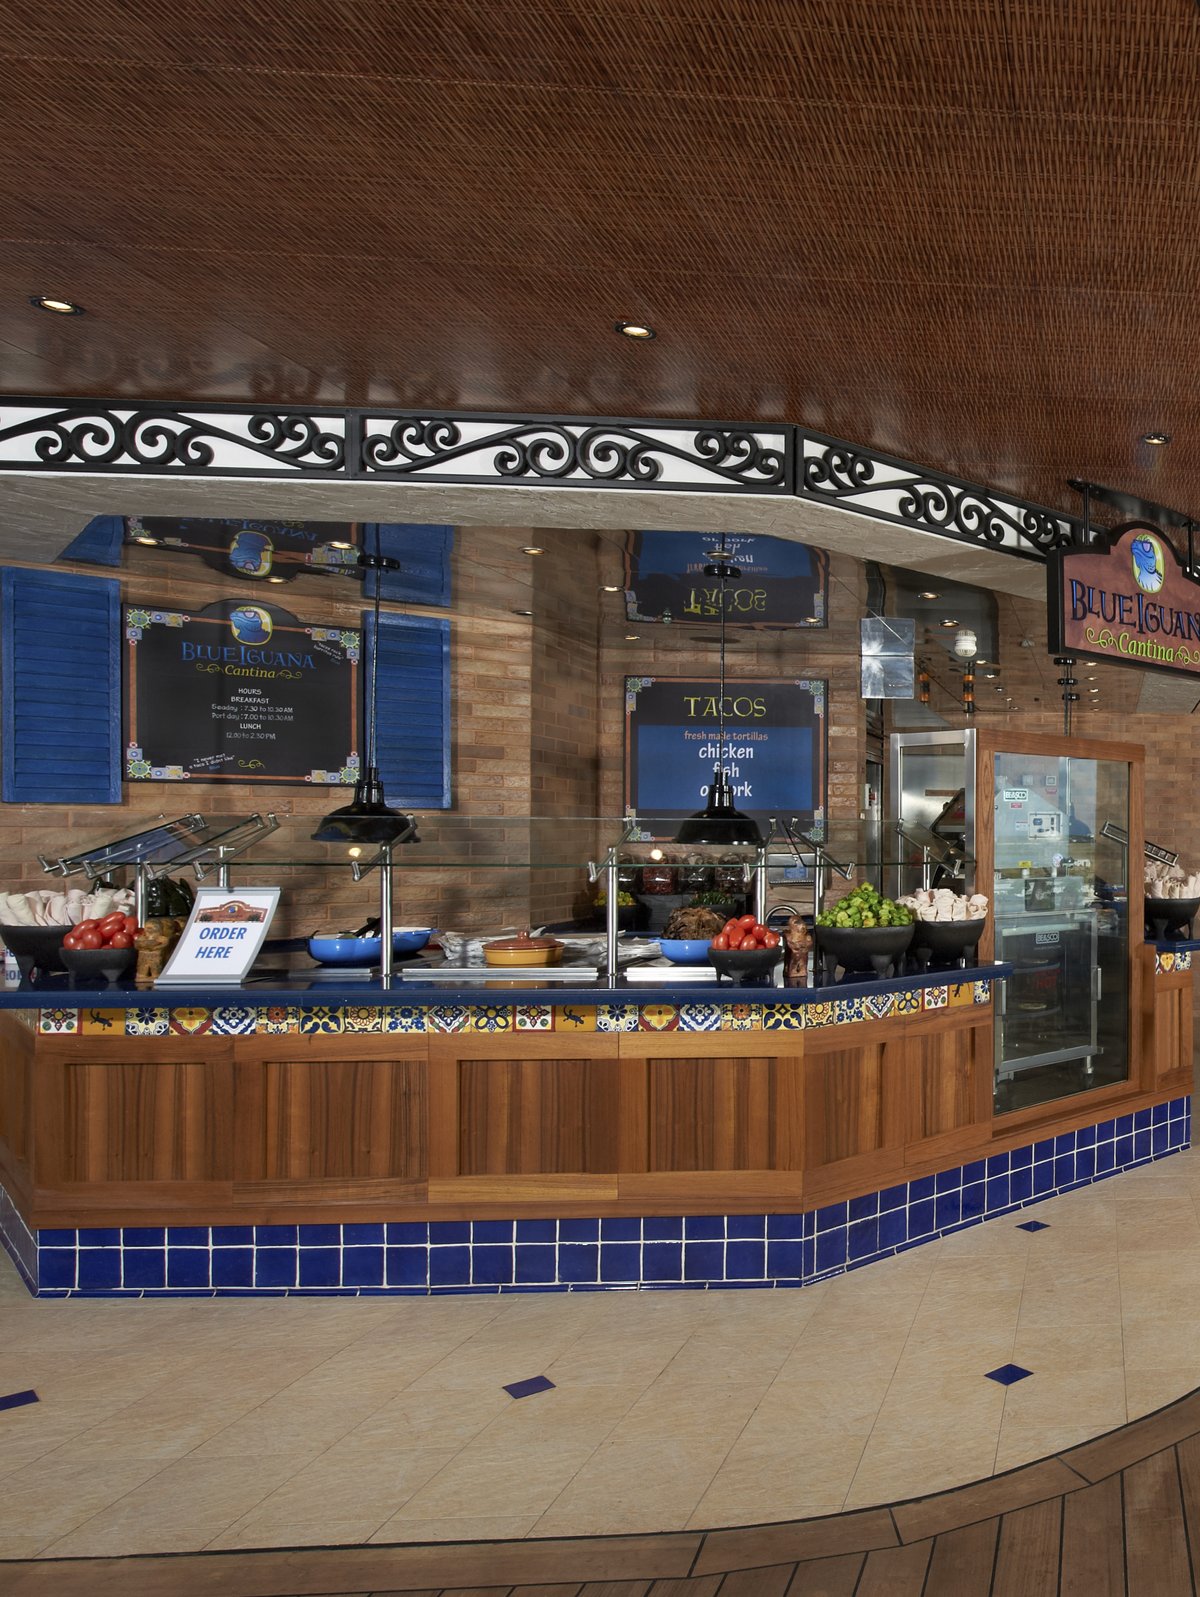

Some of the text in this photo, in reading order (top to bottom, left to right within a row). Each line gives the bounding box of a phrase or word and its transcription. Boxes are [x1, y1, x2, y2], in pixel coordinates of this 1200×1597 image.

[1119, 632, 1176, 663] Cantina
[224, 664, 276, 679] Cantina
[230, 696, 270, 704] BREAKFAST
[683, 697, 768, 718] TACOS
[684, 730, 707, 741] fresh
[732, 732, 769, 742] tortillas
[698, 742, 754, 759] chicken
[199, 927, 248, 940] ORDER
[194, 946, 233, 959] HERE
